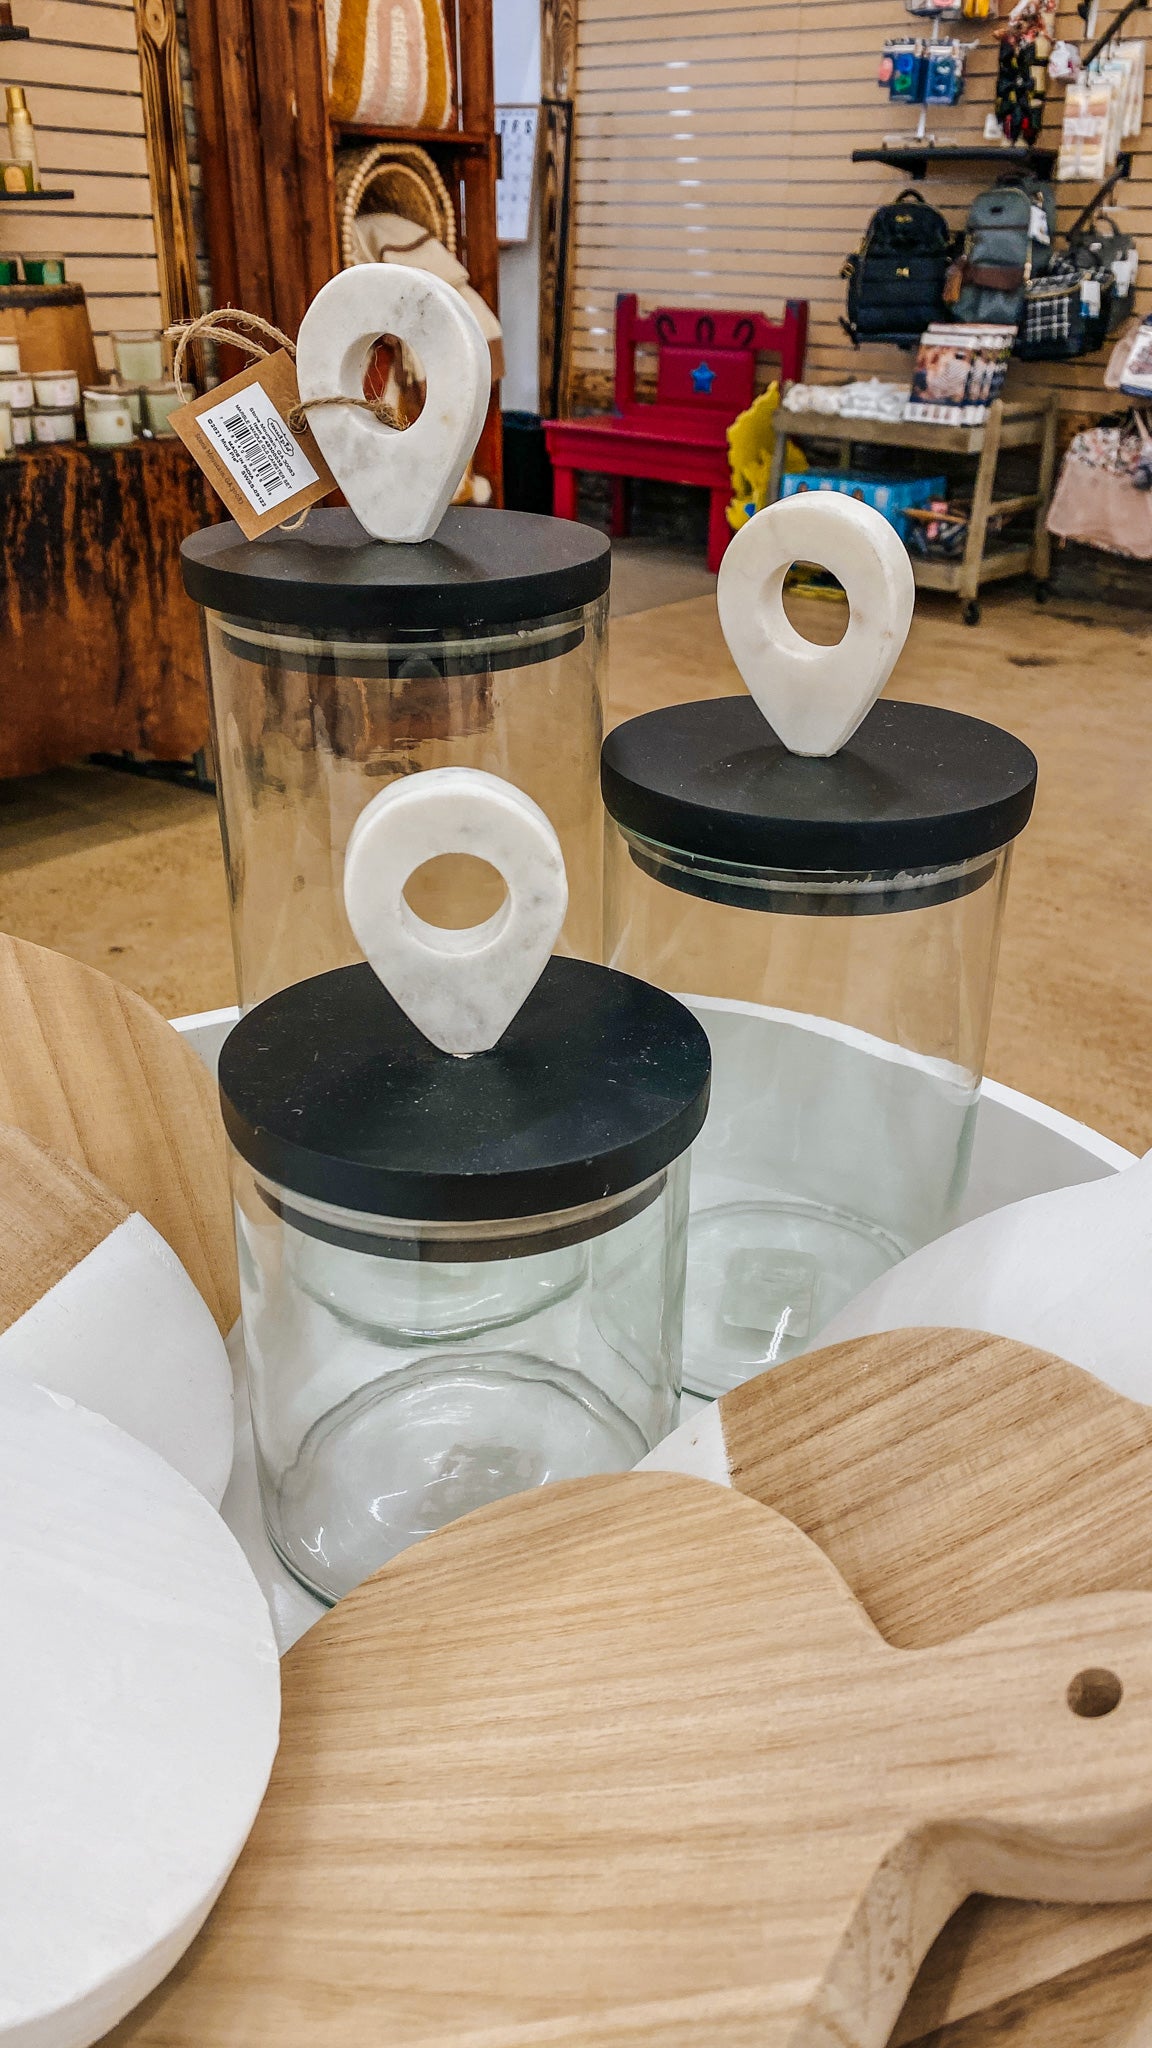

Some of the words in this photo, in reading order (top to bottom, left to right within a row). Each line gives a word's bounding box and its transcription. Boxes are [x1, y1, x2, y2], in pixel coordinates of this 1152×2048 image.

[219, 437, 230, 451] Mud
[234, 403, 250, 424] MARBLE
[247, 423, 263, 444] HANDLE
[266, 453, 285, 479] CANISTER
[283, 478, 292, 490] SET
[248, 406, 262, 423] Stone
[275, 449, 284, 459] GA
[282, 458, 295, 477] 30083
[252, 421, 263, 435] Item
[194, 433, 208, 450] Stone
[223, 476, 233, 487] GA
[227, 440, 240, 457] MADE
[242, 464, 254, 479] INDIA
